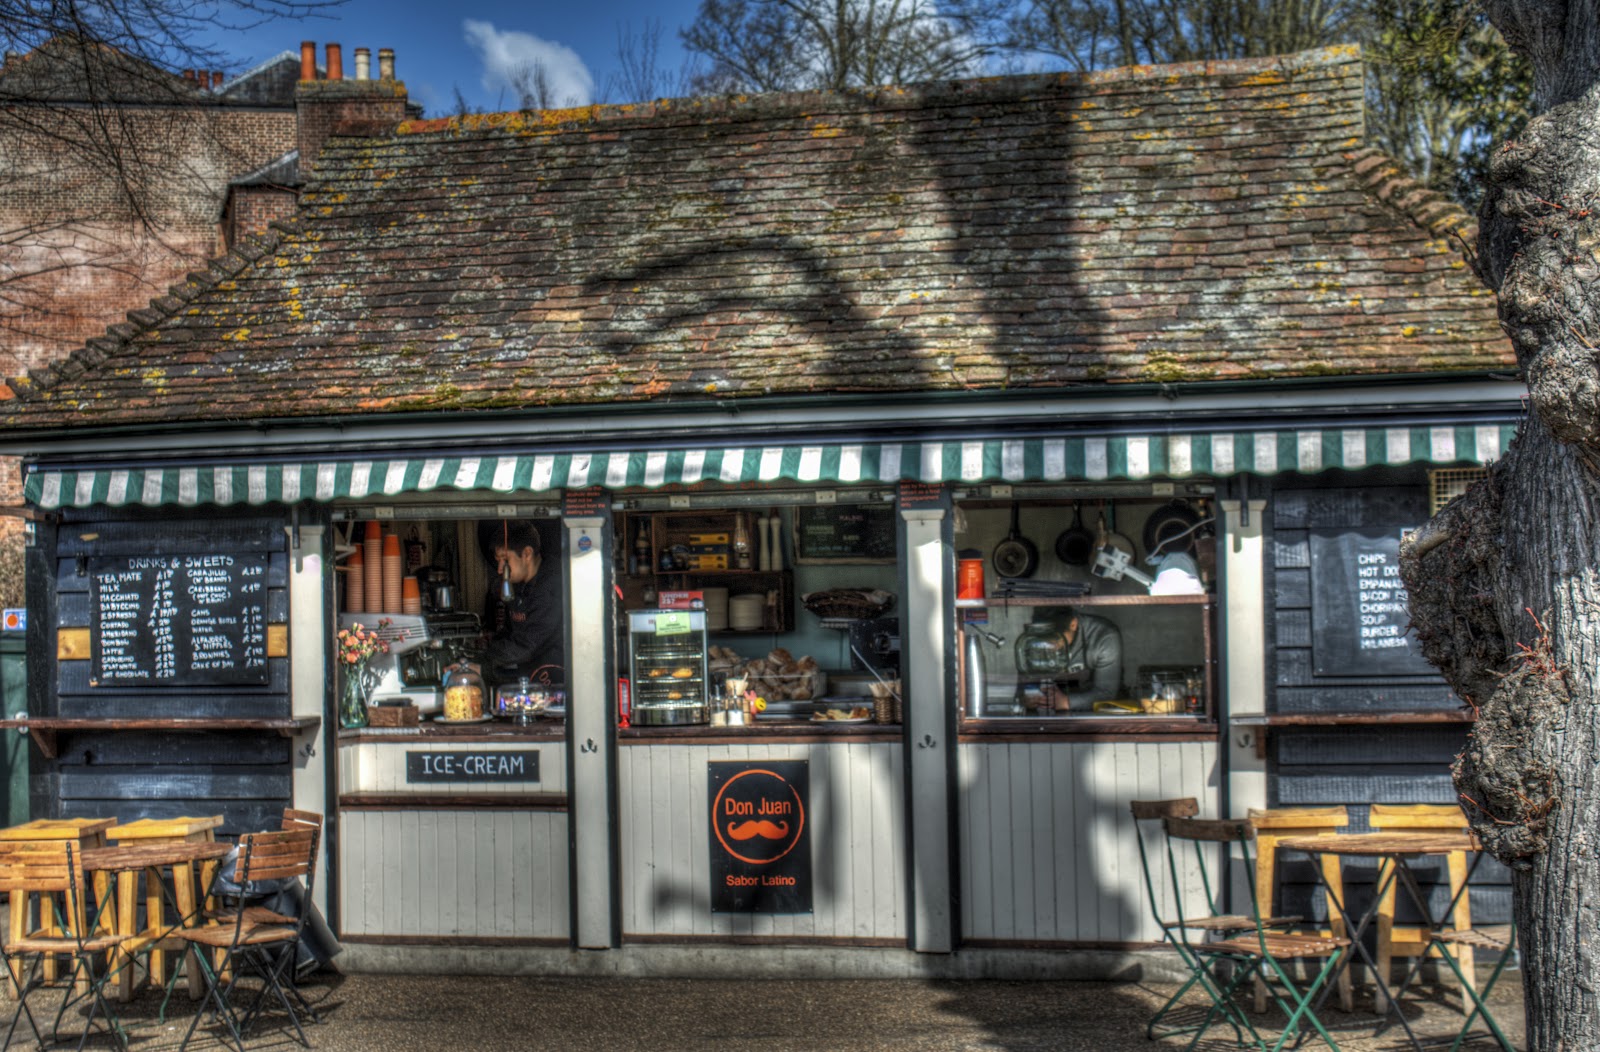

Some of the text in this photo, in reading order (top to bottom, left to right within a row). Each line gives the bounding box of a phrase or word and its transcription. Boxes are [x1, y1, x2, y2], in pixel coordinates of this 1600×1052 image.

[129, 555, 234, 569] DRINKS & SWEETS
[1358, 553, 1387, 565] CHIPS
[1358, 566, 1378, 577] HOT
[100, 584, 120, 593] MILK
[1359, 579, 1404, 590] EMPANAD
[100, 593, 140, 602] MACCHIATO
[101, 611, 137, 621] ESPRESSO
[191, 608, 210, 617] CANS
[100, 621, 130, 630] CORTADO
[1361, 614, 1387, 626] SOUP
[1361, 625, 1399, 637] BURGER
[1361, 637, 1408, 649] MILANESA
[102, 647, 124, 656] LATTE
[192, 650, 230, 661] BROWNIES
[422, 755, 524, 775] ICE-CREAM
[725, 797, 791, 815] Don Juan
[726, 875, 796, 886] Sabor Latino
